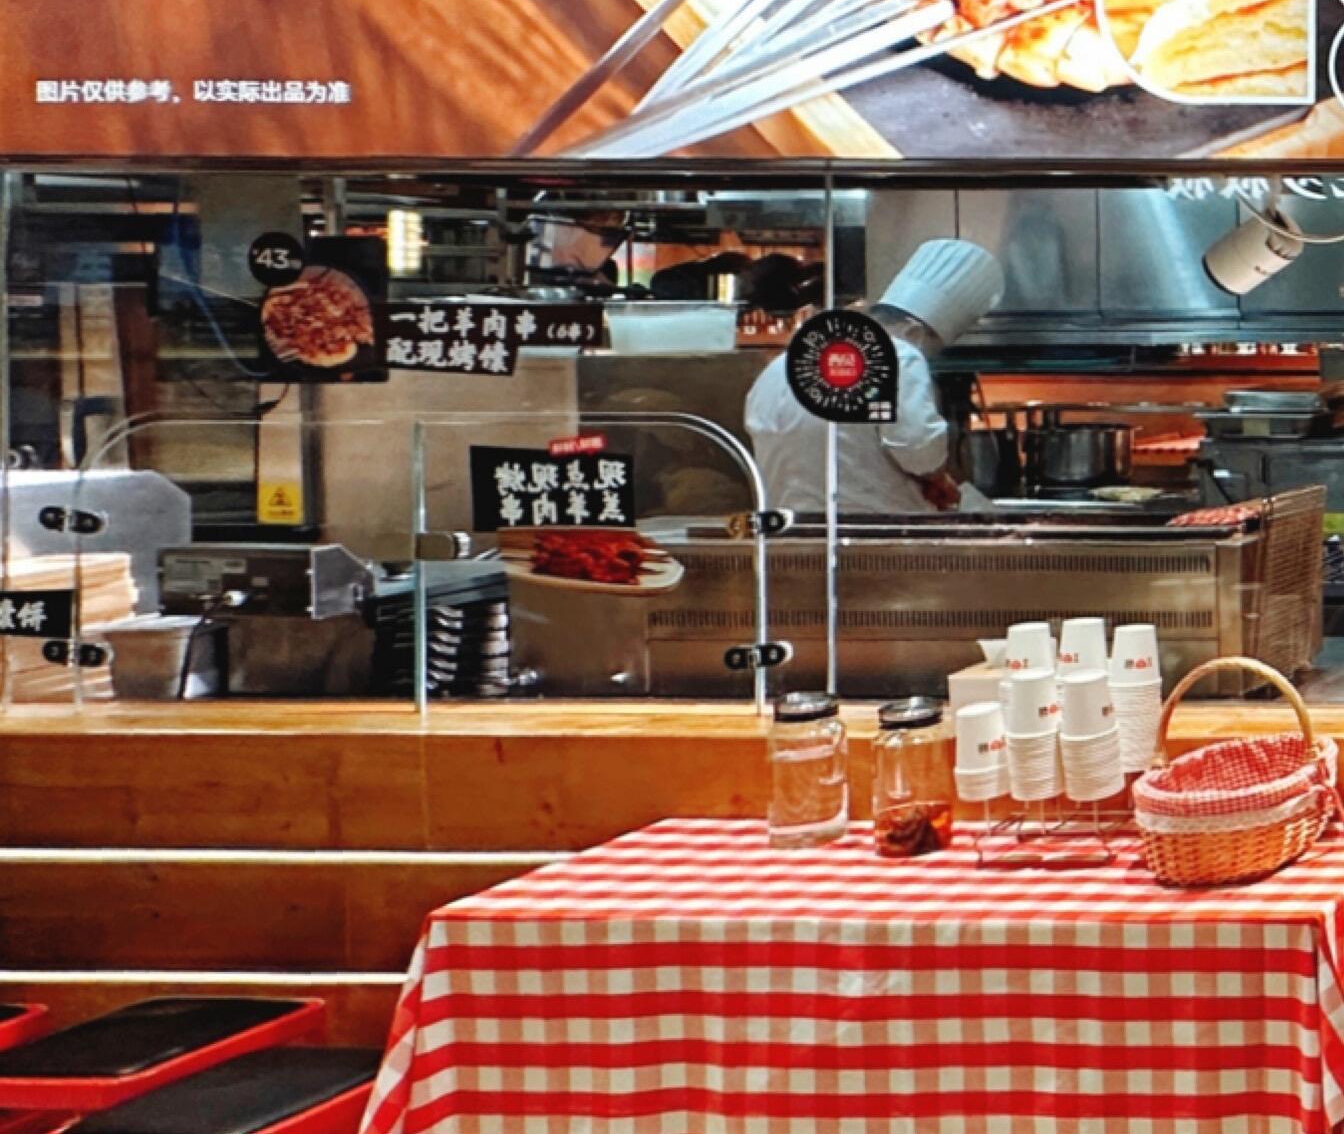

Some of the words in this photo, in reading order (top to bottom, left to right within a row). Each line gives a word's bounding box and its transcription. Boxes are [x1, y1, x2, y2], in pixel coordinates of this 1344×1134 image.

[390, 306, 537, 340] 一把羊肉串
